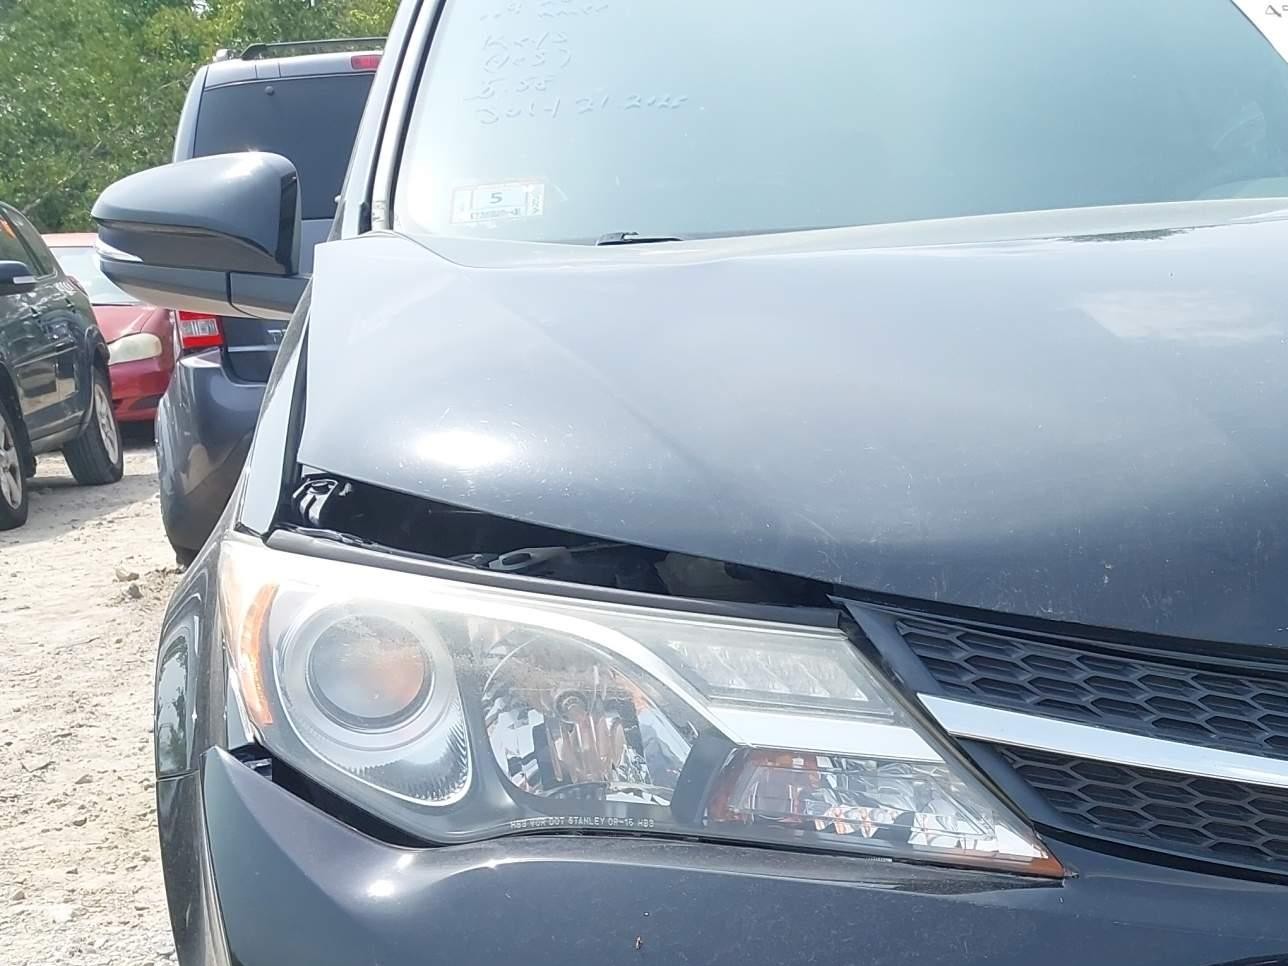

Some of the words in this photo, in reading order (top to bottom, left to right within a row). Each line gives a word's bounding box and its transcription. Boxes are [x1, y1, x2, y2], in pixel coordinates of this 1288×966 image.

[488, 191, 504, 204] 5
[548, 816, 565, 826] DOT
[567, 816, 606, 826] STANLEY
